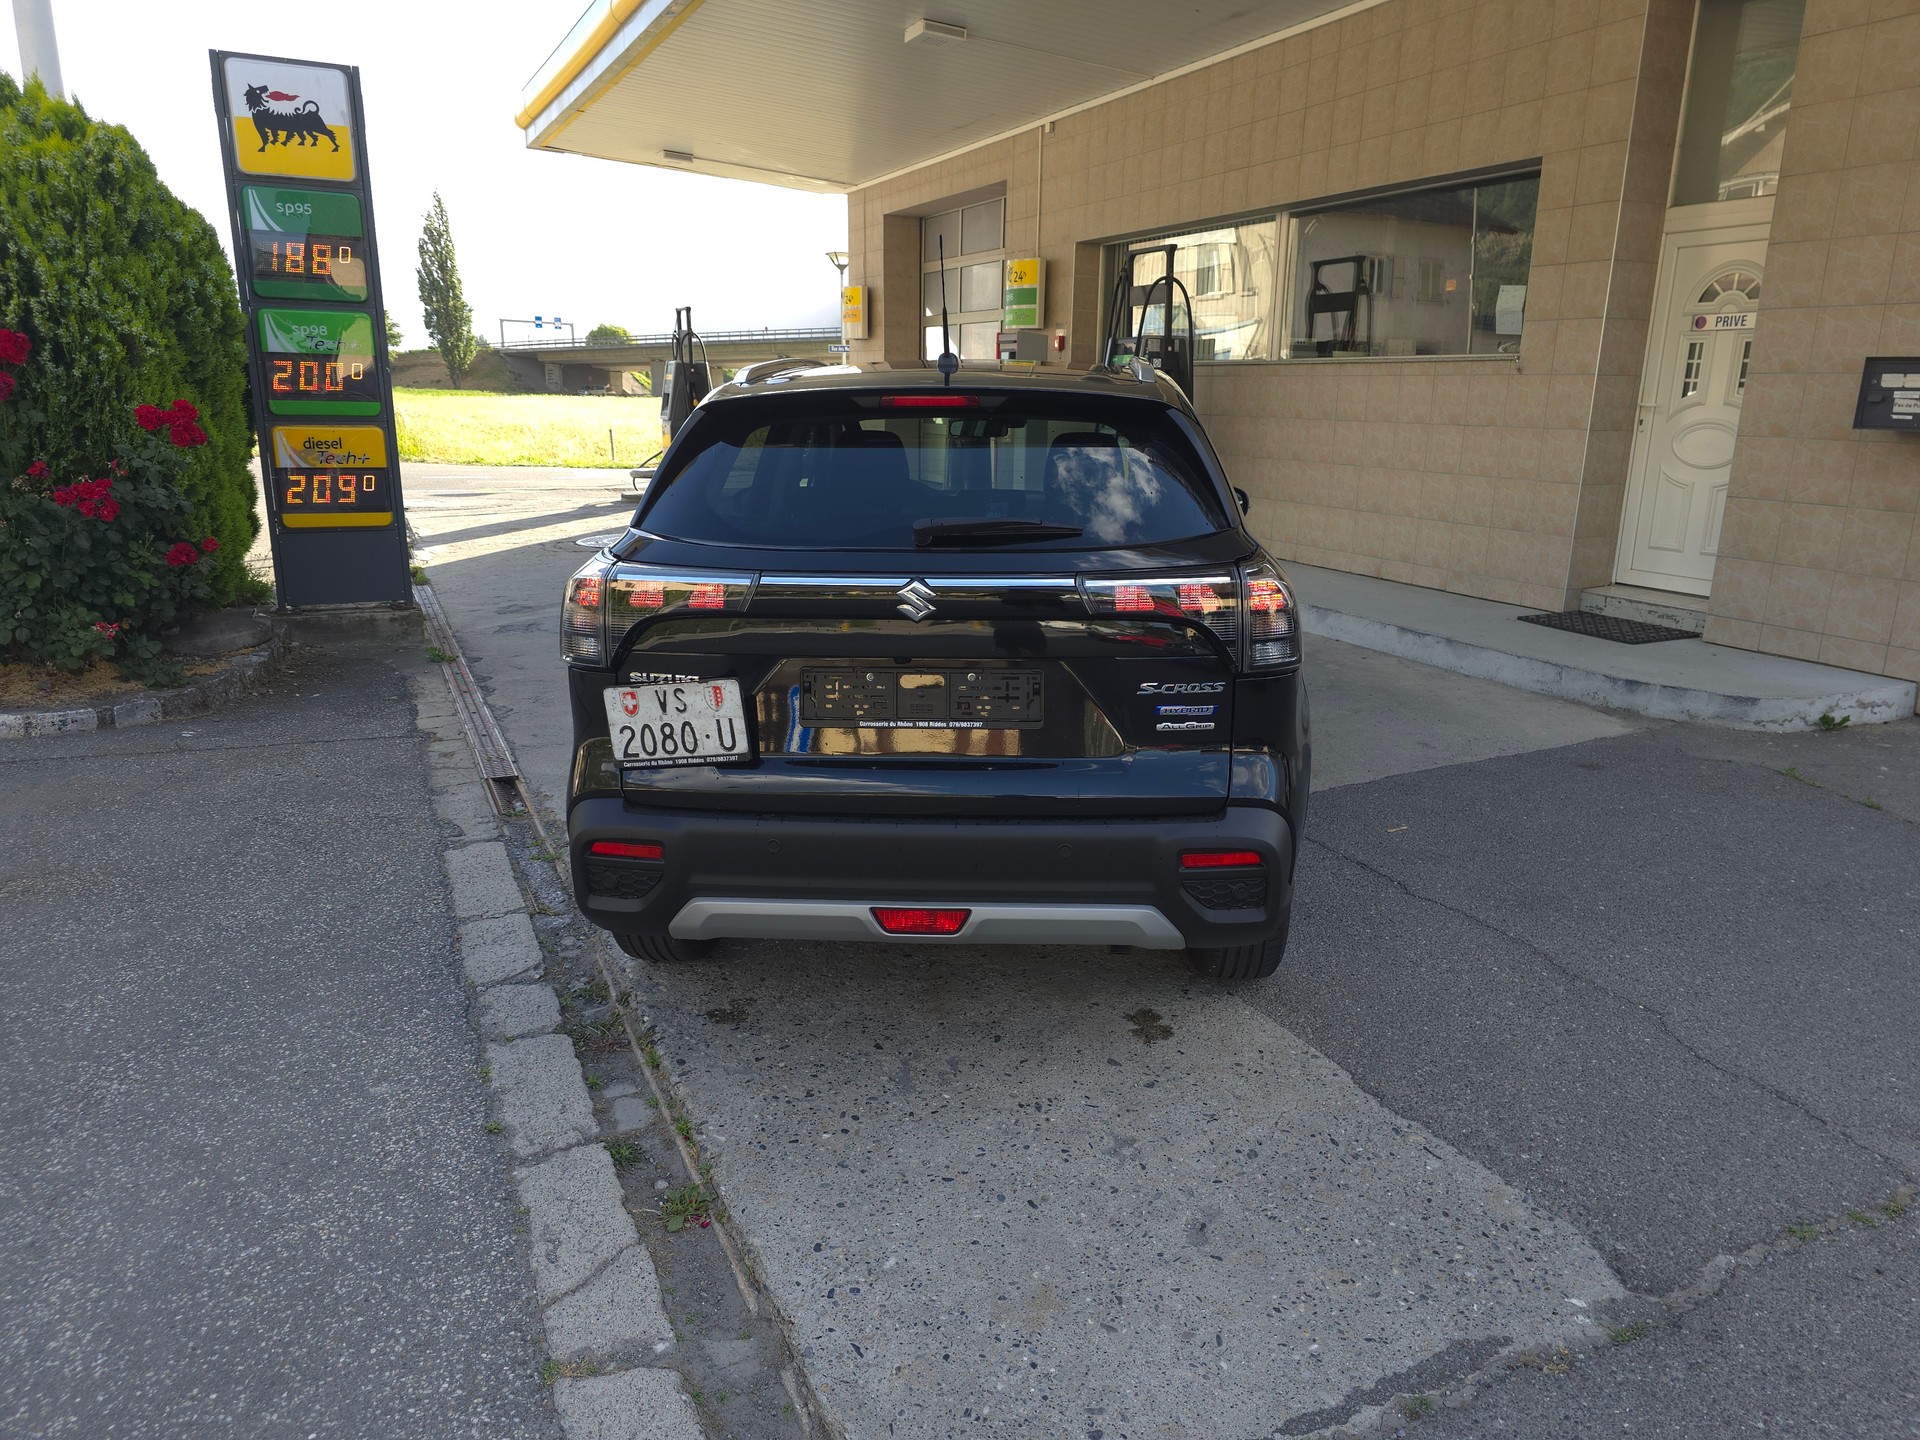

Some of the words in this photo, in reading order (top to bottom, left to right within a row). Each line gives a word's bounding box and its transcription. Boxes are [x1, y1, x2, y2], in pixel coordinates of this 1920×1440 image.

[276, 201, 312, 221] sp95
[1715, 314, 1748, 328] PRIVE
[291, 325, 328, 338] sp98
[303, 437, 342, 450] diesel
[317, 451, 370, 465] Tech+
[654, 687, 688, 714] VS
